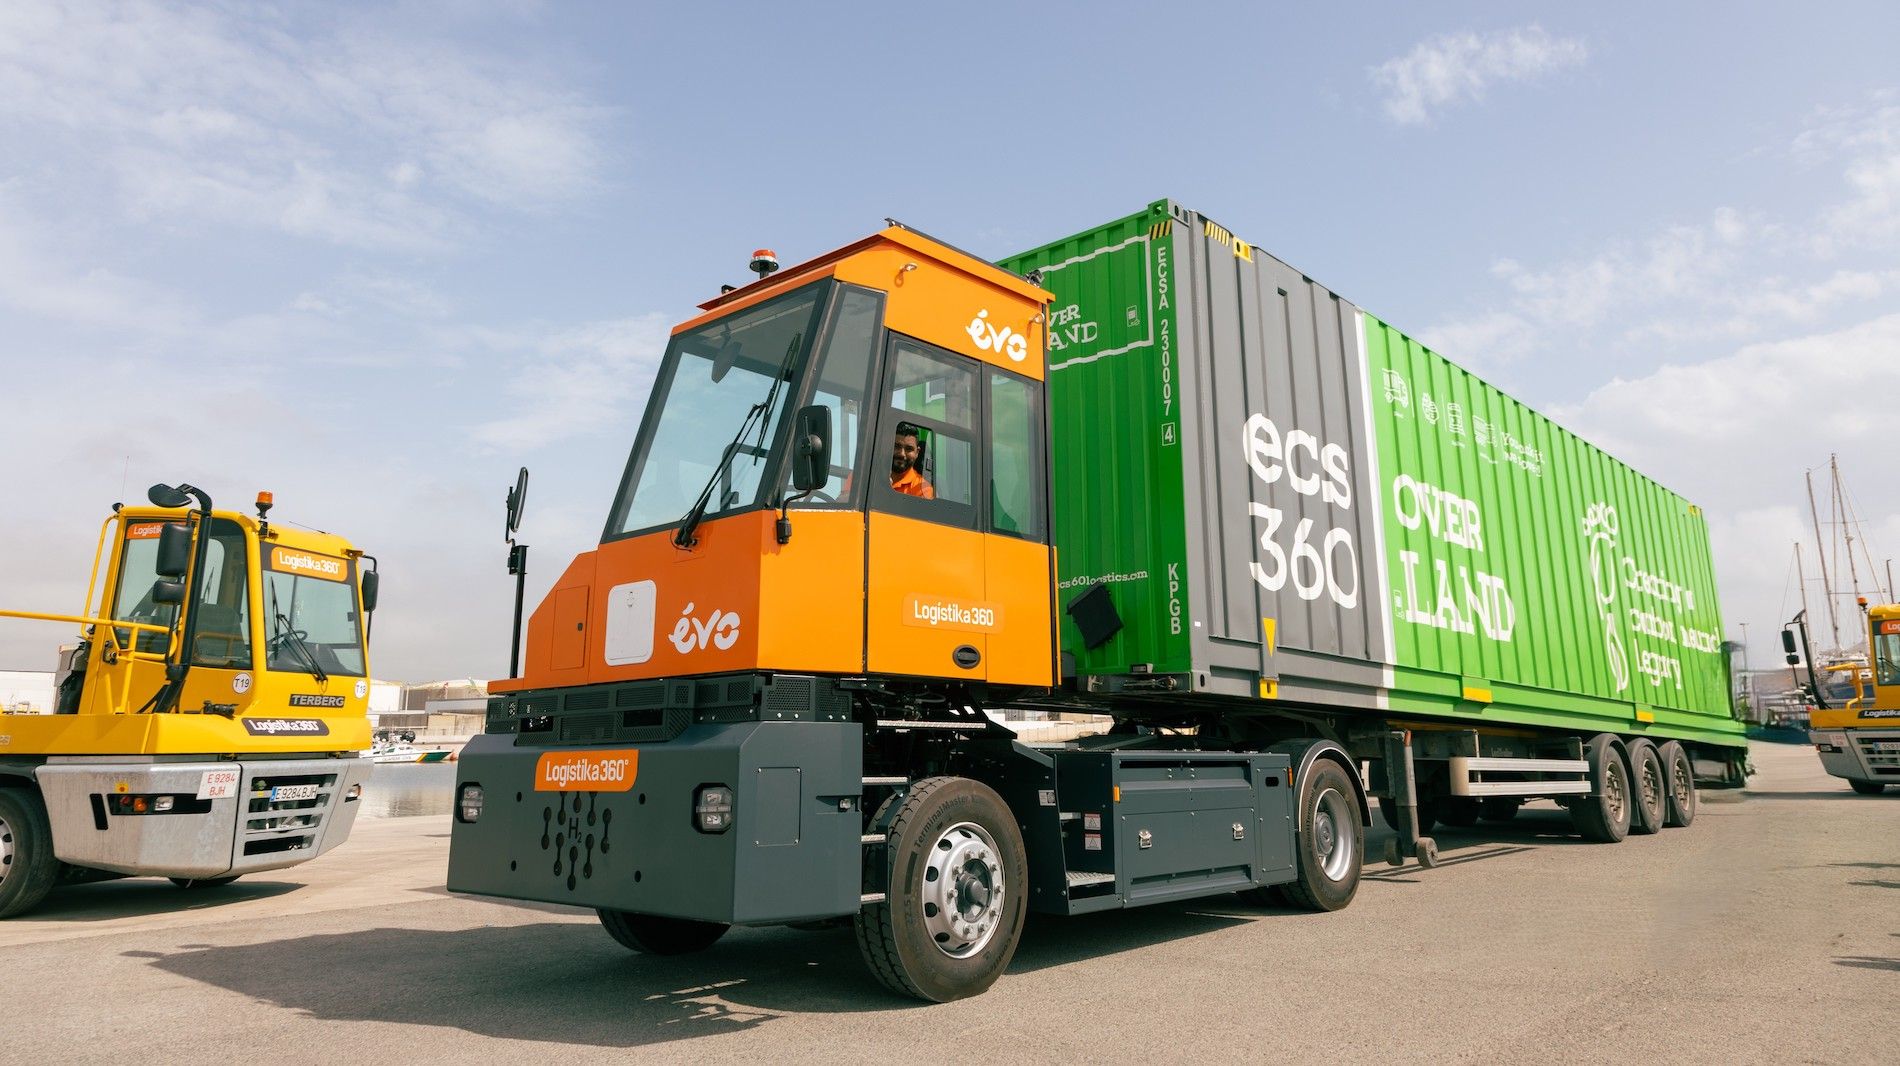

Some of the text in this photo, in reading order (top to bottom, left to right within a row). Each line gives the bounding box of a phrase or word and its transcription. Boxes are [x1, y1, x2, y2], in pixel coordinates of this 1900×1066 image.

[1157, 246, 1169, 310] ECSA
[965, 308, 1027, 362] évo
[1049, 304, 1081, 327] VER
[1049, 321, 1098, 351] AND
[1160, 319, 1172, 416] 230007
[1243, 413, 1351, 510] ecs
[1393, 474, 1484, 552] OVER
[1249, 501, 1358, 609] 360
[668, 601, 741, 654] évo
[1168, 562, 1181, 635] KPGB
[1399, 549, 1516, 642] LAND
[292, 695, 345, 706] TERBERG
